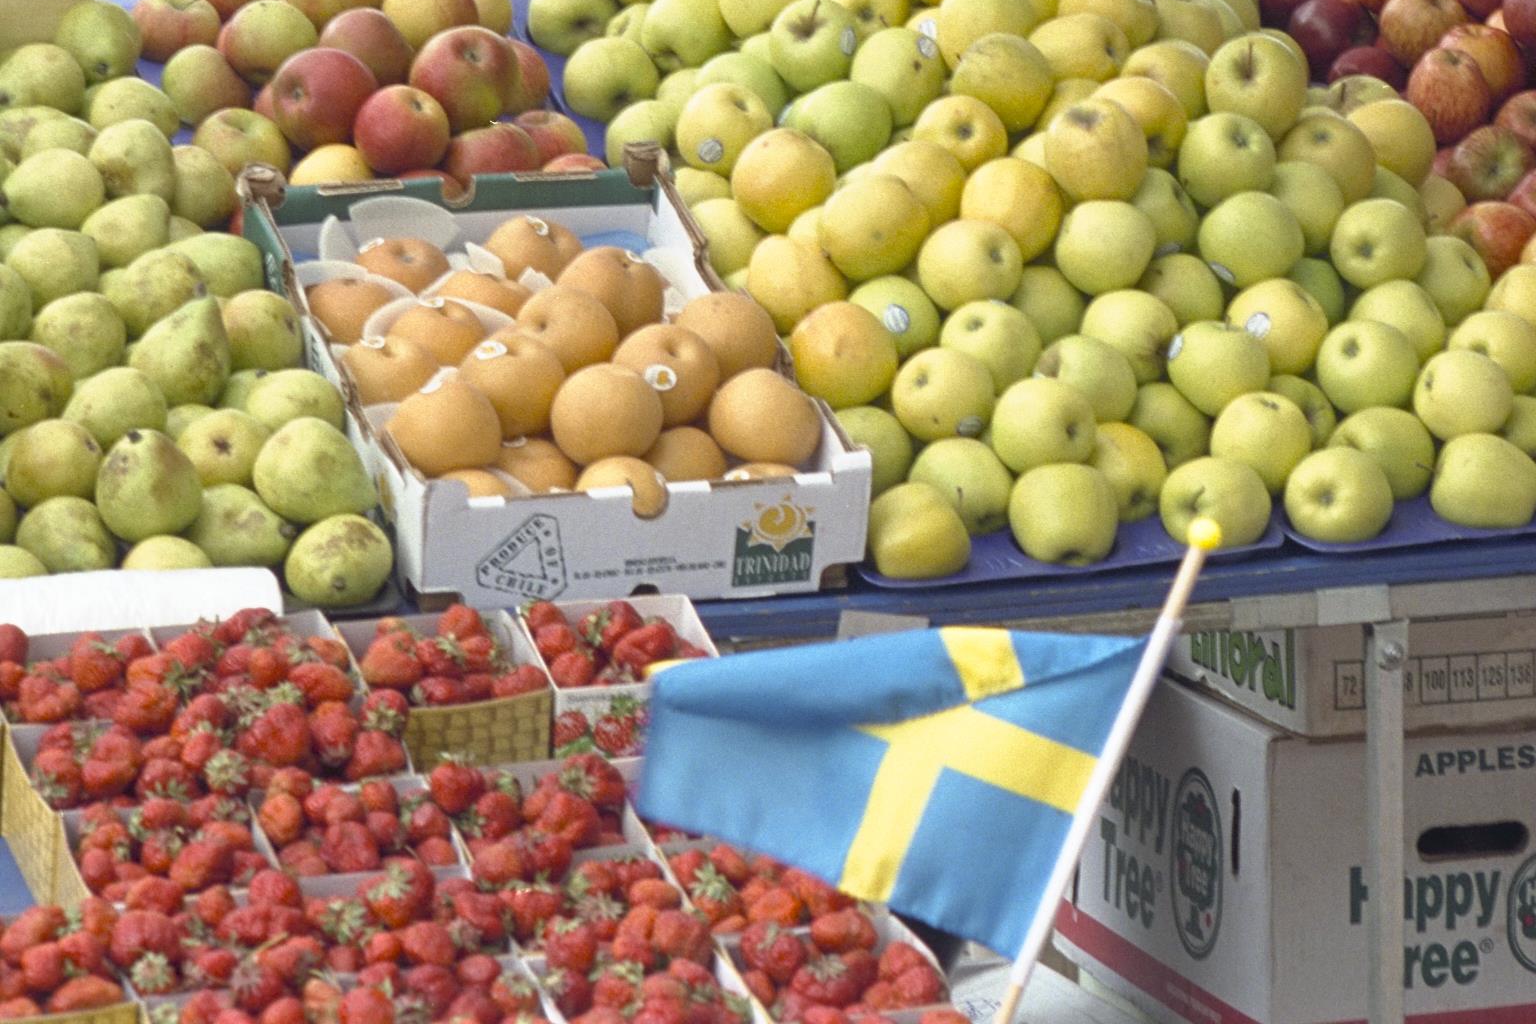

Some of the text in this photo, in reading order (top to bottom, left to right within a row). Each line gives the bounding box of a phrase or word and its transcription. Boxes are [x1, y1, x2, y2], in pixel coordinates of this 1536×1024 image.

[736, 551, 811, 576] TRINIDAD
[496, 574, 547, 595] CHILE
[1342, 675, 1358, 696] 72
[1425, 669, 1445, 691] 100
[1415, 744, 1536, 777] APPLES
[1110, 755, 1170, 856] appy
[1101, 815, 1155, 931] Tree
[1350, 865, 1502, 934] ppy
[1403, 940, 1480, 989] ree
